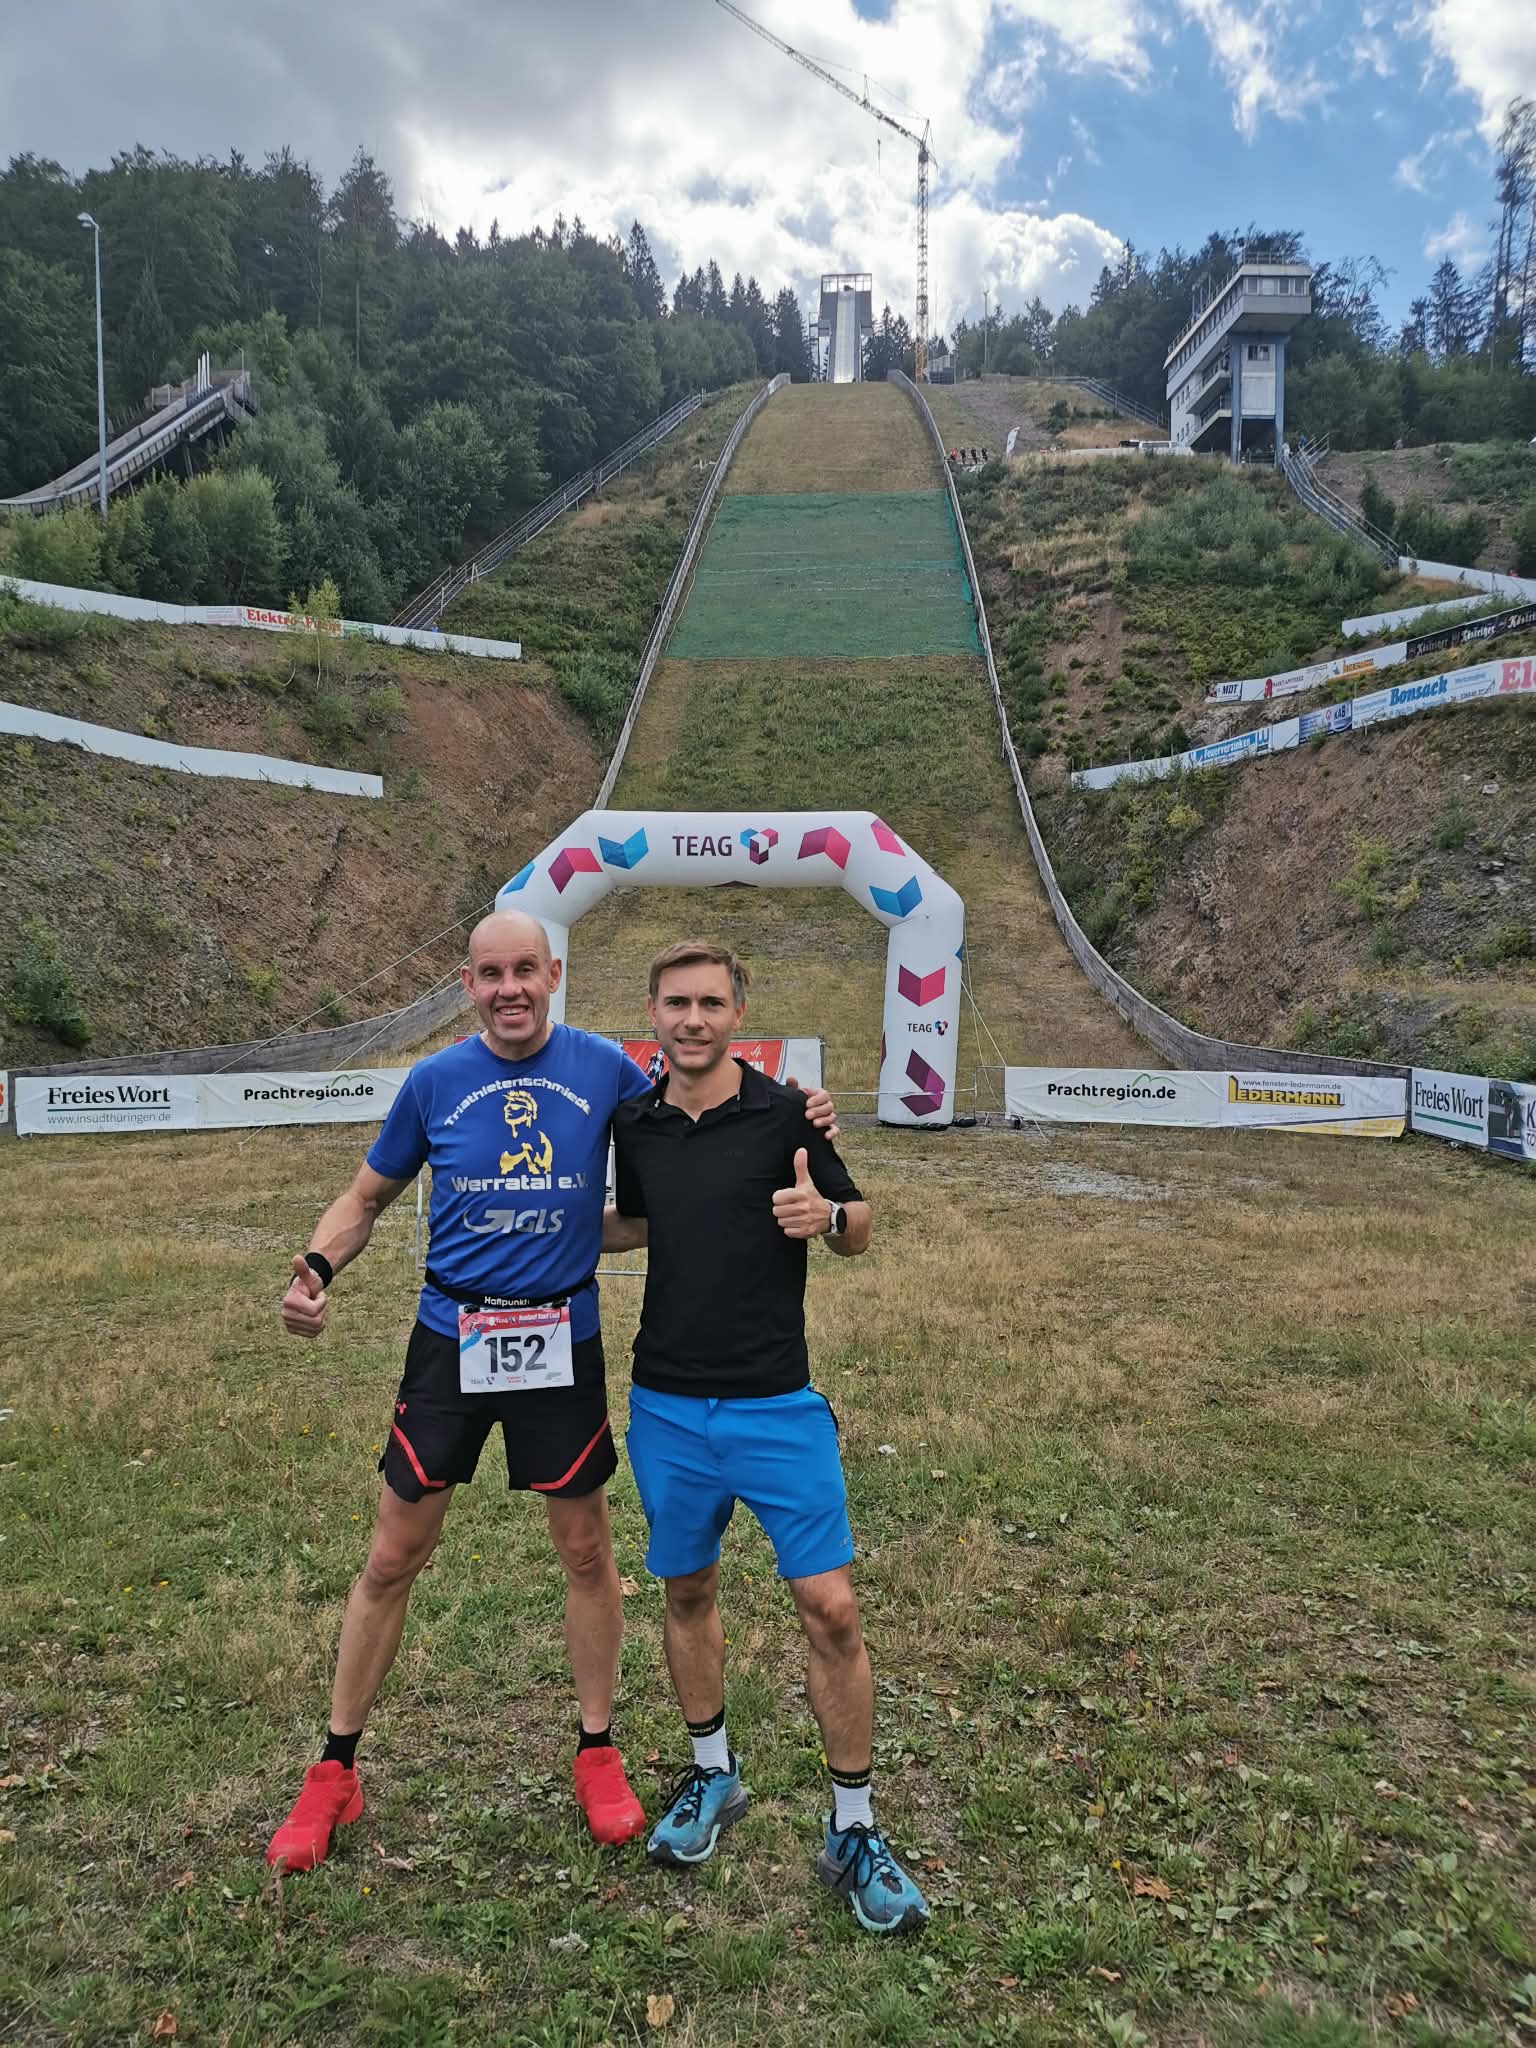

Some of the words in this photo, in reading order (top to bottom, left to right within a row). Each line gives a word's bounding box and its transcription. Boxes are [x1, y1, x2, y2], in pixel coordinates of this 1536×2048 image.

[1499, 660, 1536, 692] El
[1390, 675, 1448, 706] Bonsack
[672, 835, 732, 857] TEAG
[907, 1022, 933, 1034] TEAG
[48, 1086, 114, 1105] Freies
[117, 1086, 171, 1103] Wort
[244, 1084, 374, 1101] Prachtregion.de
[1047, 1083, 1177, 1101] Prachtregion.de
[1229, 1075, 1346, 1109] LEDERMANN
[1242, 1079, 1342, 1090] www.fenster-ledermann.de
[444, 1077, 593, 1127] Triathletenschmiede
[1415, 1081, 1451, 1113] Freies
[1451, 1086, 1485, 1119] Wort
[452, 1173, 552, 1193] Werratal
[558, 1172, 589, 1190] e.V.
[514, 1208, 565, 1234] GLS
[484, 1334, 547, 1374] 152
